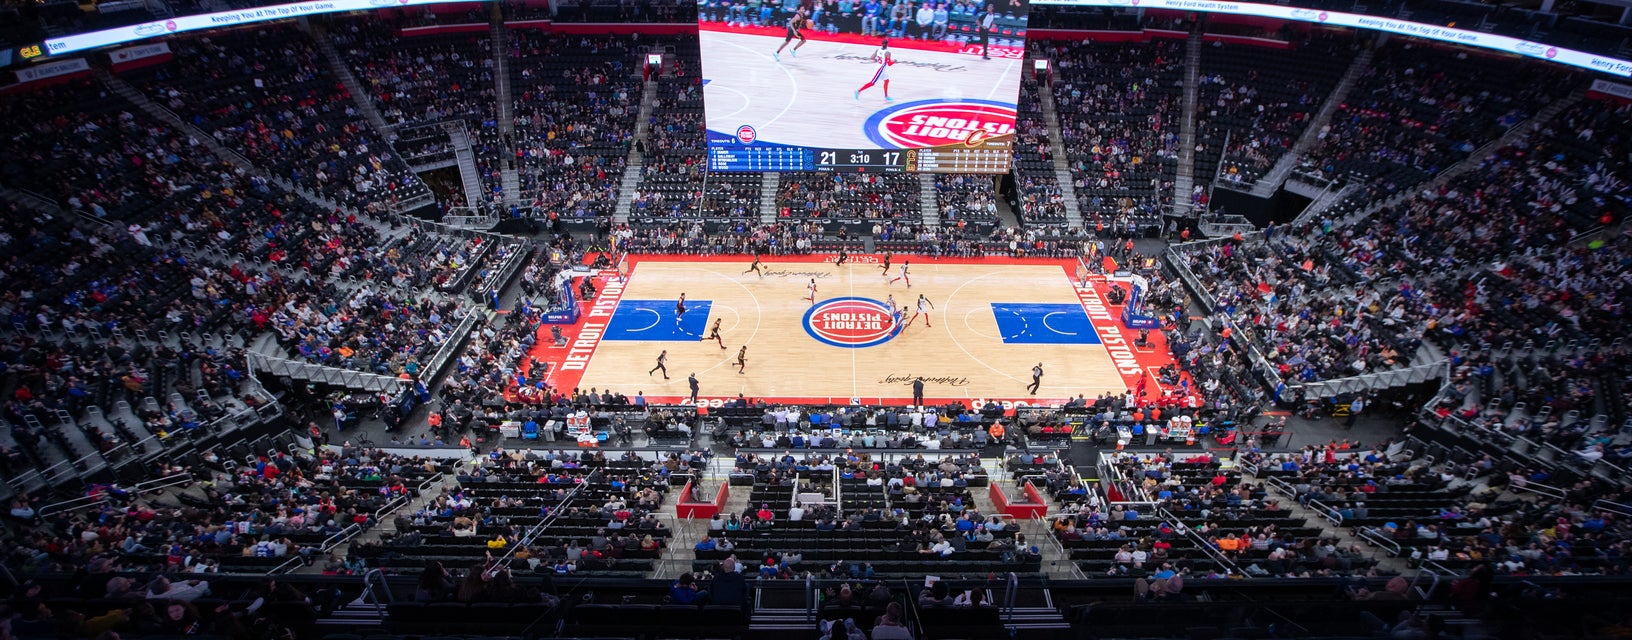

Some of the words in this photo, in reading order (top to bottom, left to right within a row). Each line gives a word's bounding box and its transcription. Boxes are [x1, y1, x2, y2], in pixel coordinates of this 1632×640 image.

[1217, 3, 1239, 11] System
[211, 13, 241, 23] Keeping
[277, 8, 290, 16] Top
[1357, 17, 1384, 28] Keeping
[1419, 26, 1431, 35] Top
[19, 45, 42, 59] CLE
[1591, 58, 1615, 70] Henry
[820, 151, 836, 165] 21
[850, 154, 870, 164] 3:10
[883, 152, 900, 165] 17
[560, 321, 605, 371] DETROIT
[588, 276, 628, 318] PISTONS
[822, 312, 882, 322] PISTONS
[823, 321, 882, 330] DETROIT
[1072, 281, 1113, 321] DETROIT
[1097, 325, 1143, 376] PISTONS
